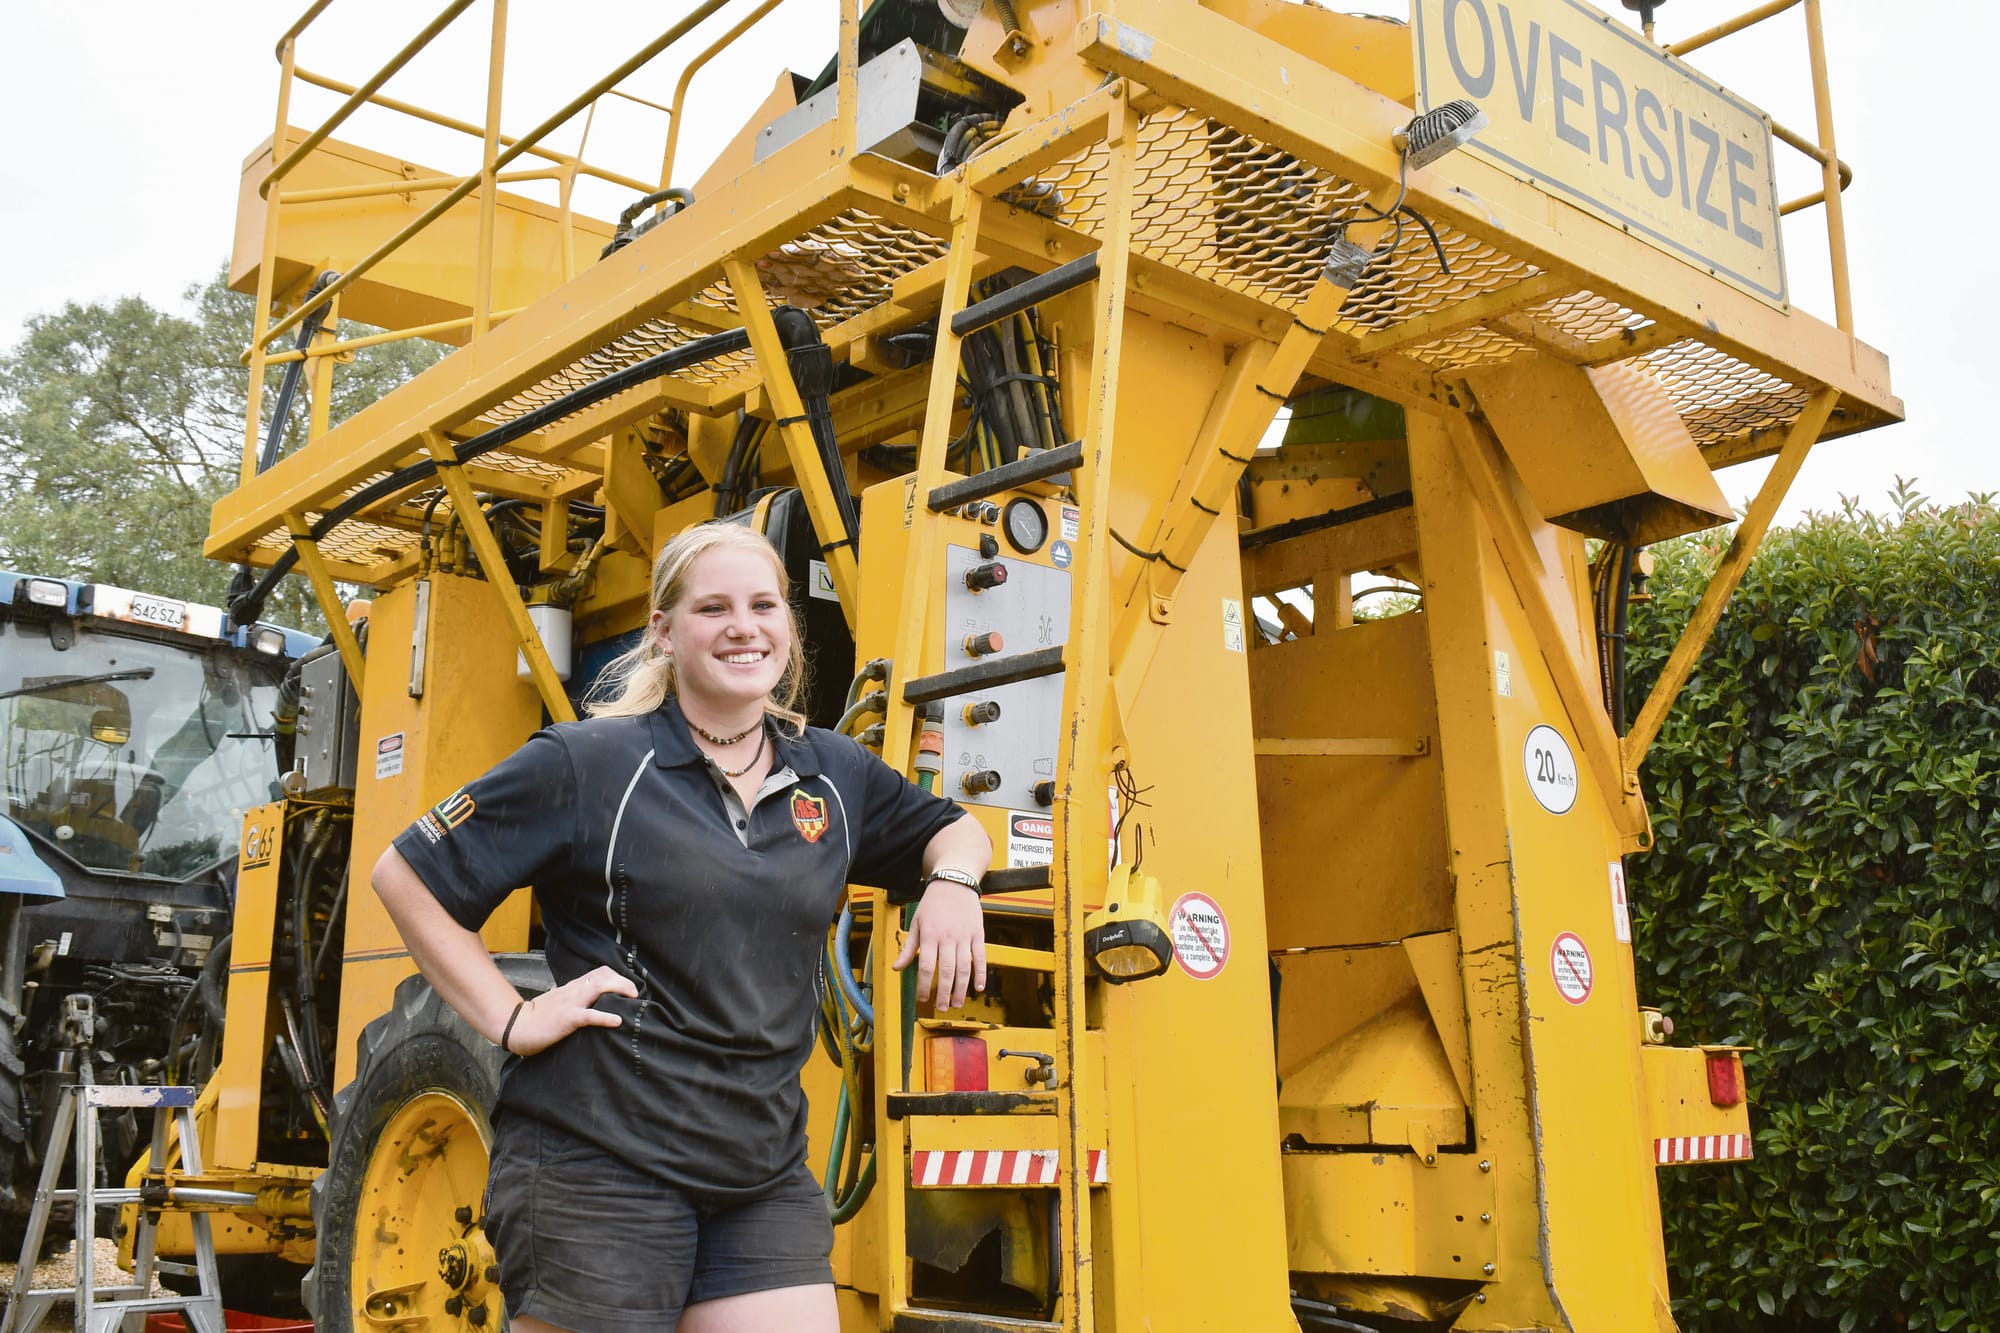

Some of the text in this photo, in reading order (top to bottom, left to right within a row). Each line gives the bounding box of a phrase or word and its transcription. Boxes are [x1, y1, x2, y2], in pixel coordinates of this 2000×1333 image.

[1443, 0, 1764, 250] OVERSIZE
[1535, 747, 1555, 784] 20
[1022, 822, 1052, 834] DANG
[1010, 843, 1053, 855] AUTHORISED PE
[1177, 911, 1220, 925] WARNING
